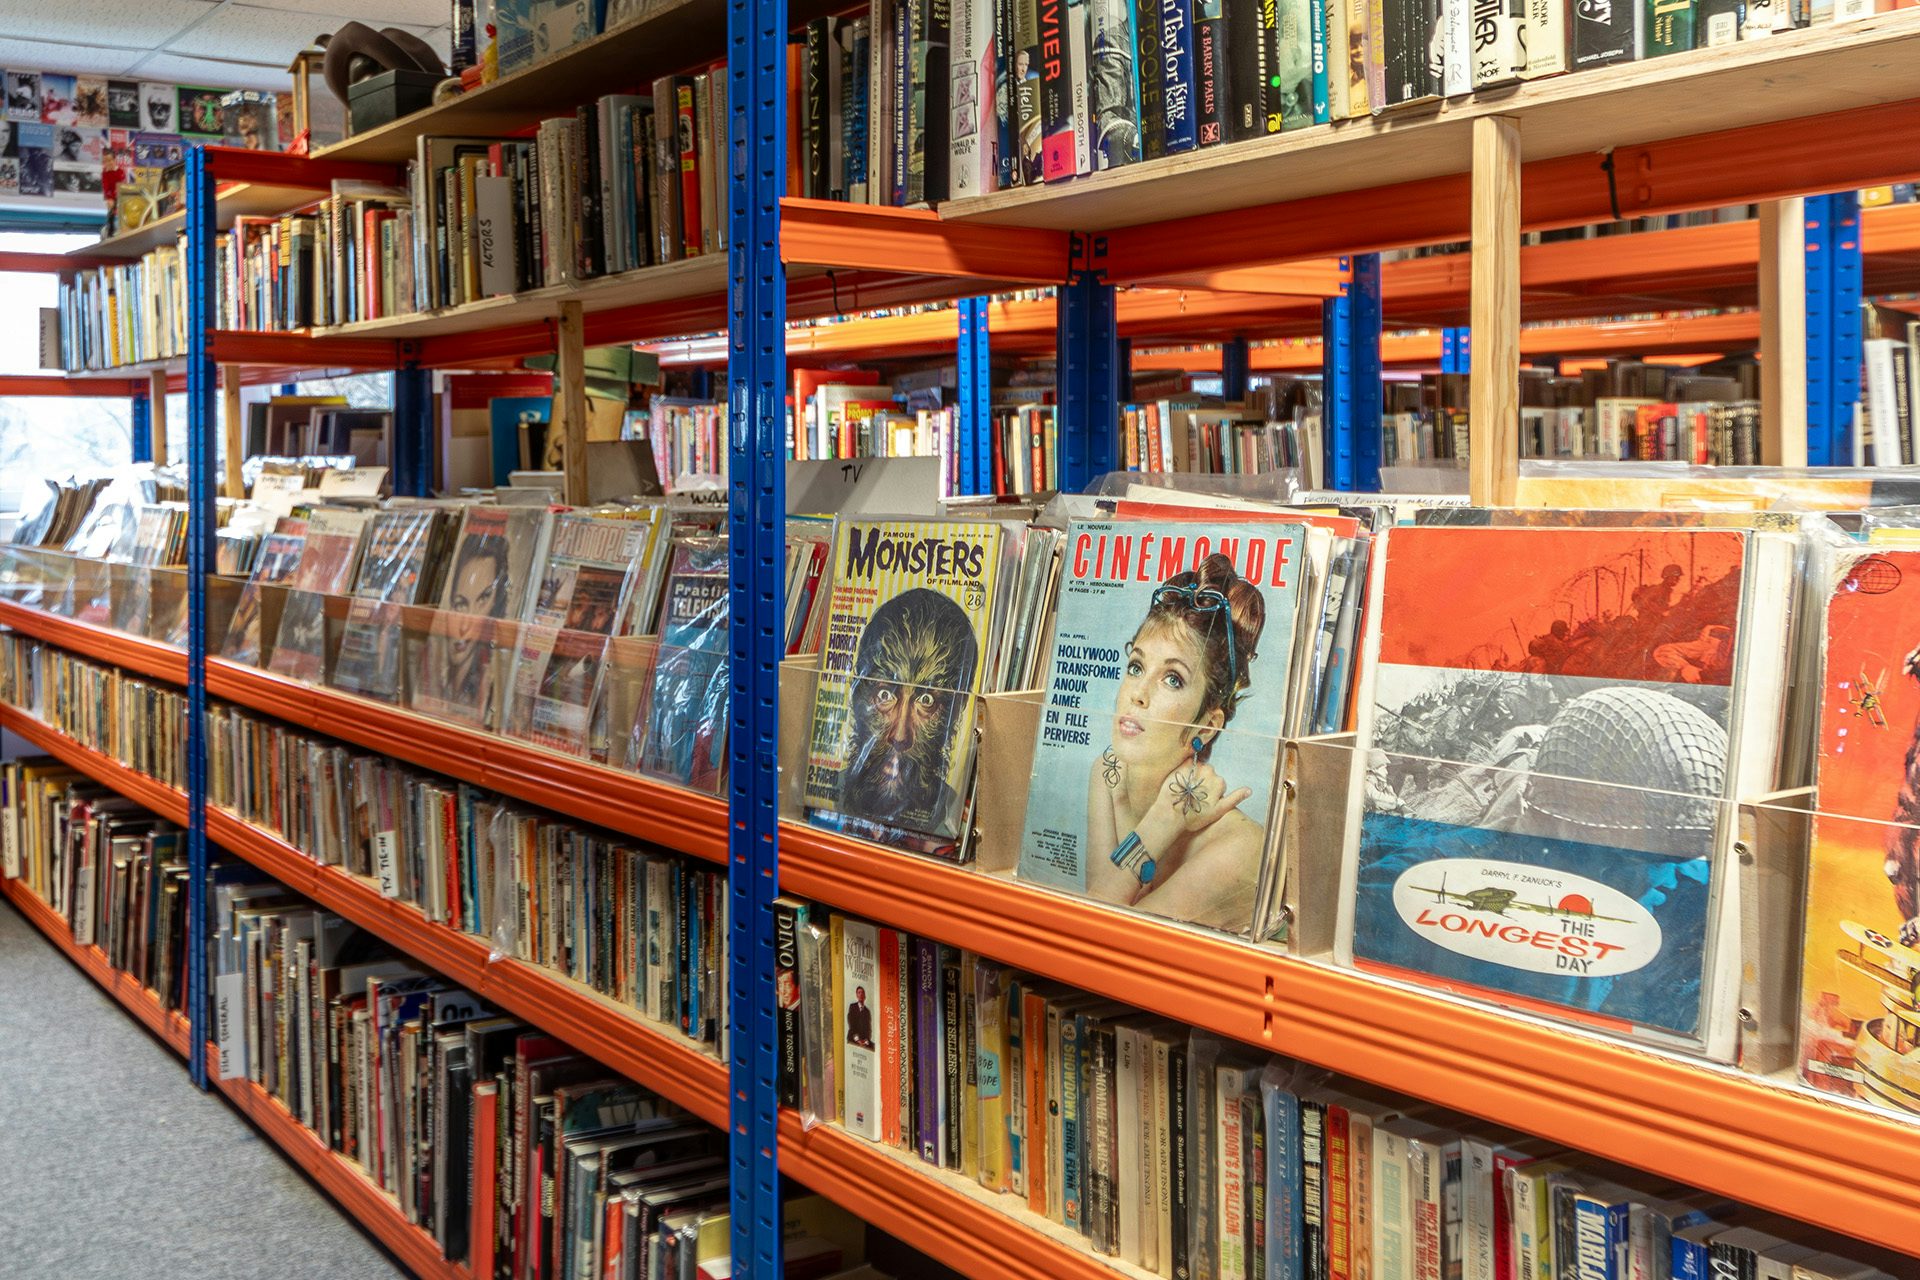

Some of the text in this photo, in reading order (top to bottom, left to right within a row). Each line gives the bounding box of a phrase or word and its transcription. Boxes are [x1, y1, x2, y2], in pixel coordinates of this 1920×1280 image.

[1161, 8, 1184, 82] Taylor
[1313, 43, 1324, 74] RIO
[1201, 26, 1215, 114] & BARRY PARIS
[1477, 67, 1500, 80] KNOPF
[808, 25, 821, 177] BRANDO
[1019, 86, 1034, 122] Hello
[1075, 82, 1085, 147] TONY BOOTH
[1166, 86, 1177, 130] Kelley
[1175, 82, 1188, 121] Kitty
[480, 218, 494, 268] ACTORS
[841, 464, 863, 483] TV
[846, 526, 985, 582] MONSTERS
[1072, 530, 1294, 589] CINÉMONDE
[940, 579, 980, 588] FILMLAND
[829, 633, 858, 652] HORROR
[831, 624, 856, 633] COLLECTION
[826, 651, 853, 672] PHOTOS
[1058, 644, 1120, 662] HOLLYWOOD
[1053, 678, 1088, 693] ANOUK
[1056, 661, 1121, 680] TRANSFORME
[1051, 693, 1081, 709] AIMÉE
[1046, 710, 1088, 728] EN FILLE
[1044, 726, 1091, 746] PERVERSE
[1480, 868, 1511, 880] DARRYL
[1520, 875, 1563, 889] ZANUCK'S
[1415, 909, 1627, 961] LONGEST
[1560, 918, 1595, 938] THE
[1555, 954, 1594, 975] DAY
[778, 914, 795, 1073] DINO NICK TOSCHES
[947, 991, 957, 1025] PETER
[885, 1006, 896, 1064] groucho
[899, 942, 907, 1108] THE STANLEY HOLLOWAY MONOLOGUES
[947, 1026, 957, 1077] SELLERS:
[1122, 1042, 1129, 1053] My
[1064, 1043, 1076, 1190] SHOWDOWN ERROL FLYNN
[1095, 1071, 1109, 1180] MOMMIE DEAREST
[1177, 1104, 1185, 1130] Actor
[1331, 1137, 1346, 1152] THE
[1222, 1097, 1241, 1237] THE MOON'S A BALLOON
[1331, 1153, 1346, 1180] WHOLE
[1256, 1186, 1264, 1221] WICKED
[1332, 1205, 1347, 1224] AND
[1427, 1202, 1438, 1233] WHO'S
[1415, 1199, 1427, 1246] ELIZABETH
[1222, 1240, 1231, 1271] NIVEN
[1427, 1232, 1438, 1266] AFRAID
[1333, 1258, 1348, 1275] BUT
